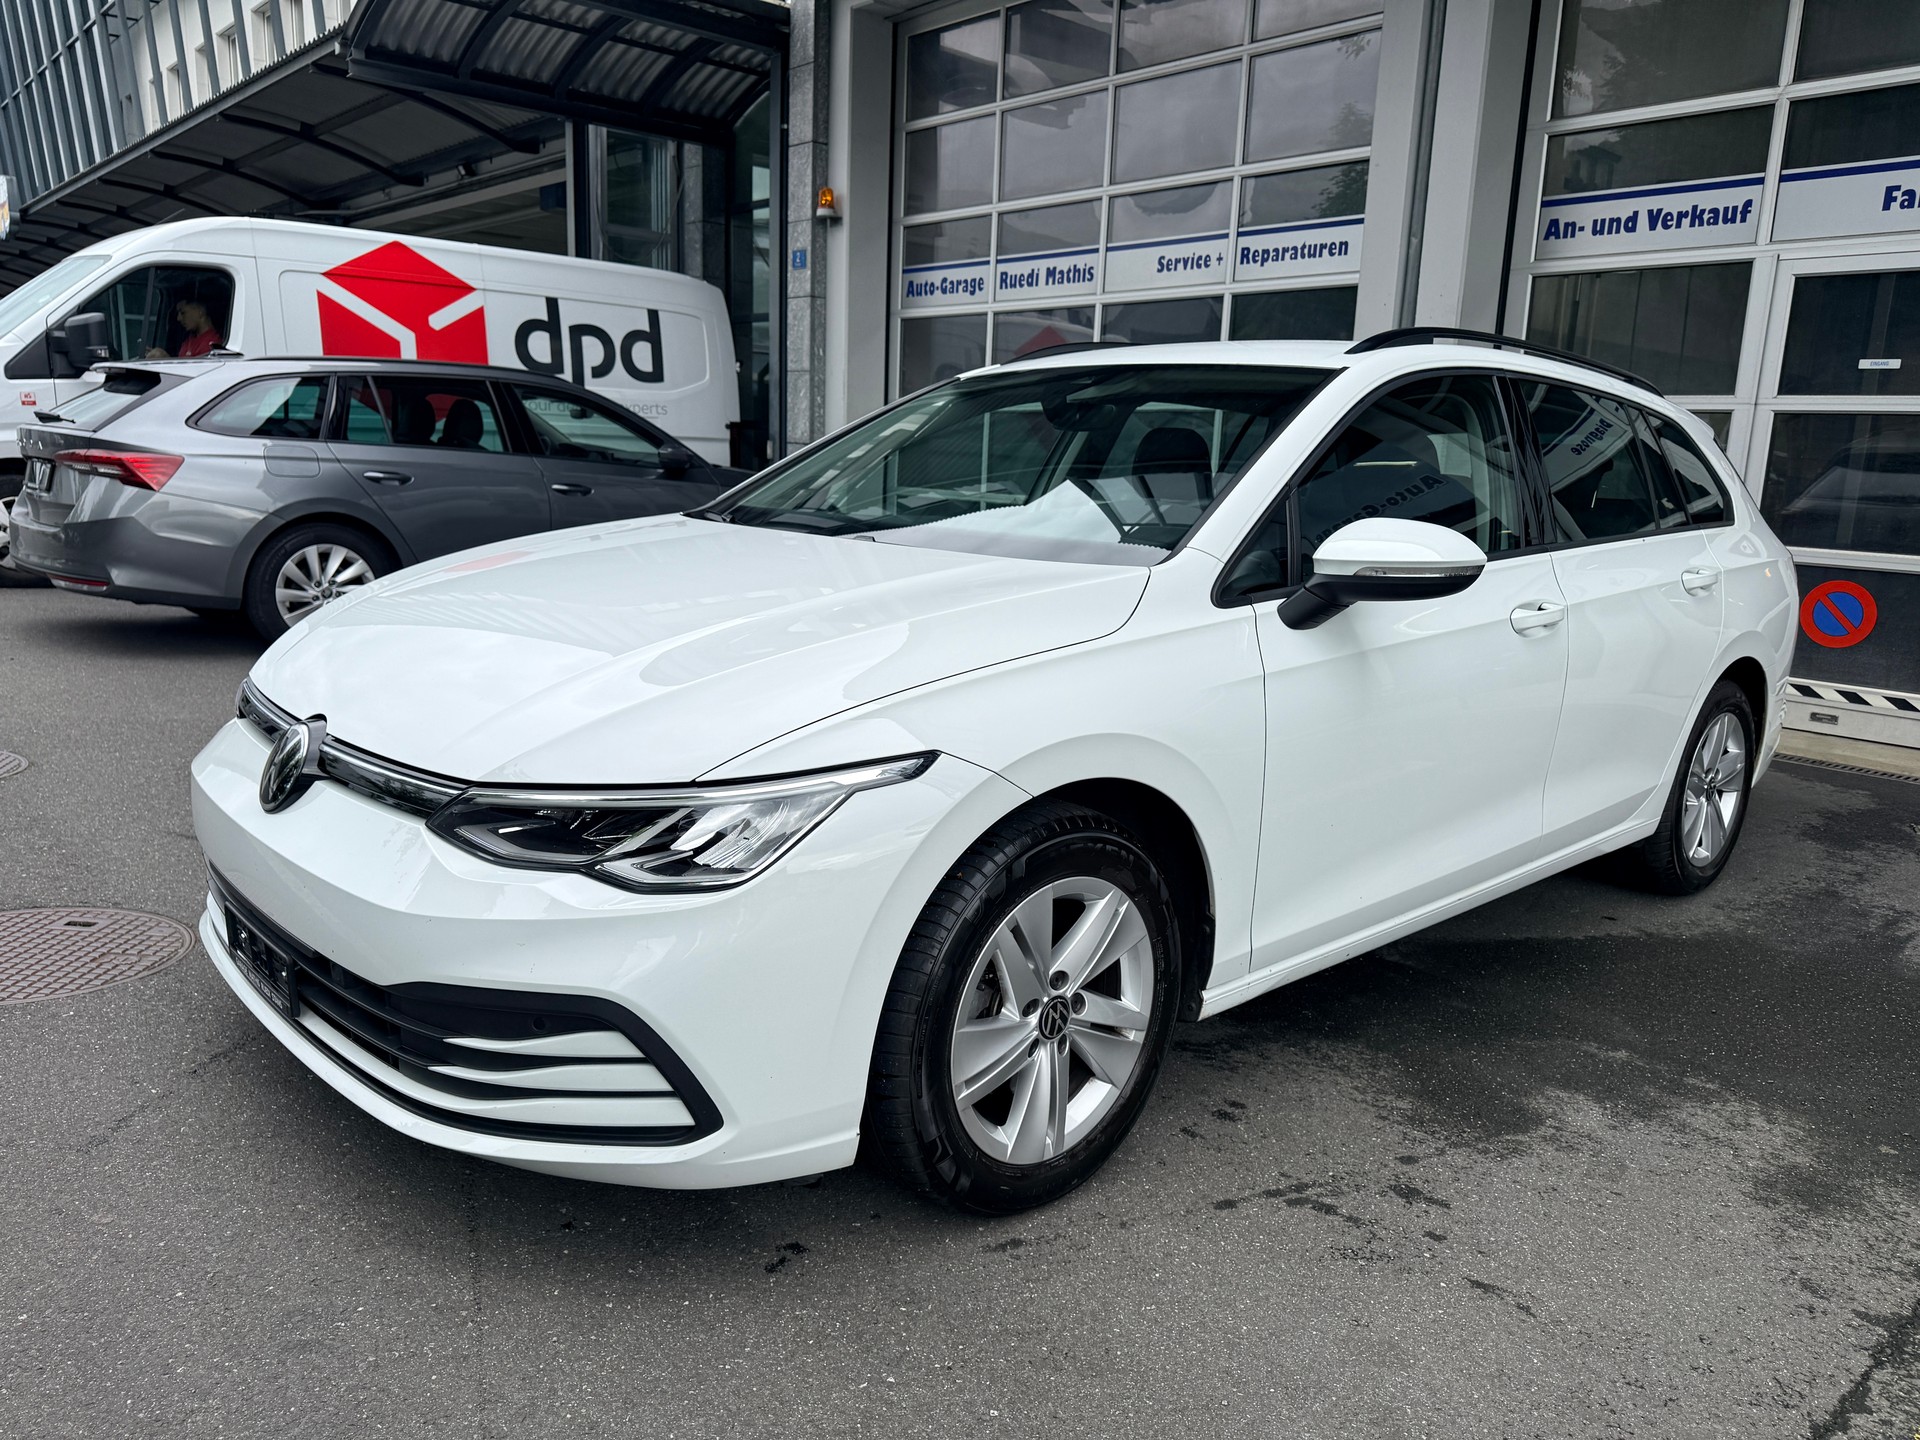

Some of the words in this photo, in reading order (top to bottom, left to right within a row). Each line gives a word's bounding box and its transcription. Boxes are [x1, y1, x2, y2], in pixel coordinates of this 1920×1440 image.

[1882, 185, 1920, 211] Fa
[1543, 218, 1585, 241] An-
[1591, 210, 1639, 236] und
[1647, 198, 1753, 231] Verkauf
[1156, 252, 1211, 273] Service
[1216, 252, 1224, 266] +
[1240, 240, 1349, 267] Reparaturen
[906, 276, 985, 298] Auto-Garage
[1000, 268, 1039, 290] Ruedi
[1045, 263, 1094, 286] Mathis
[515, 296, 664, 388] dpd
